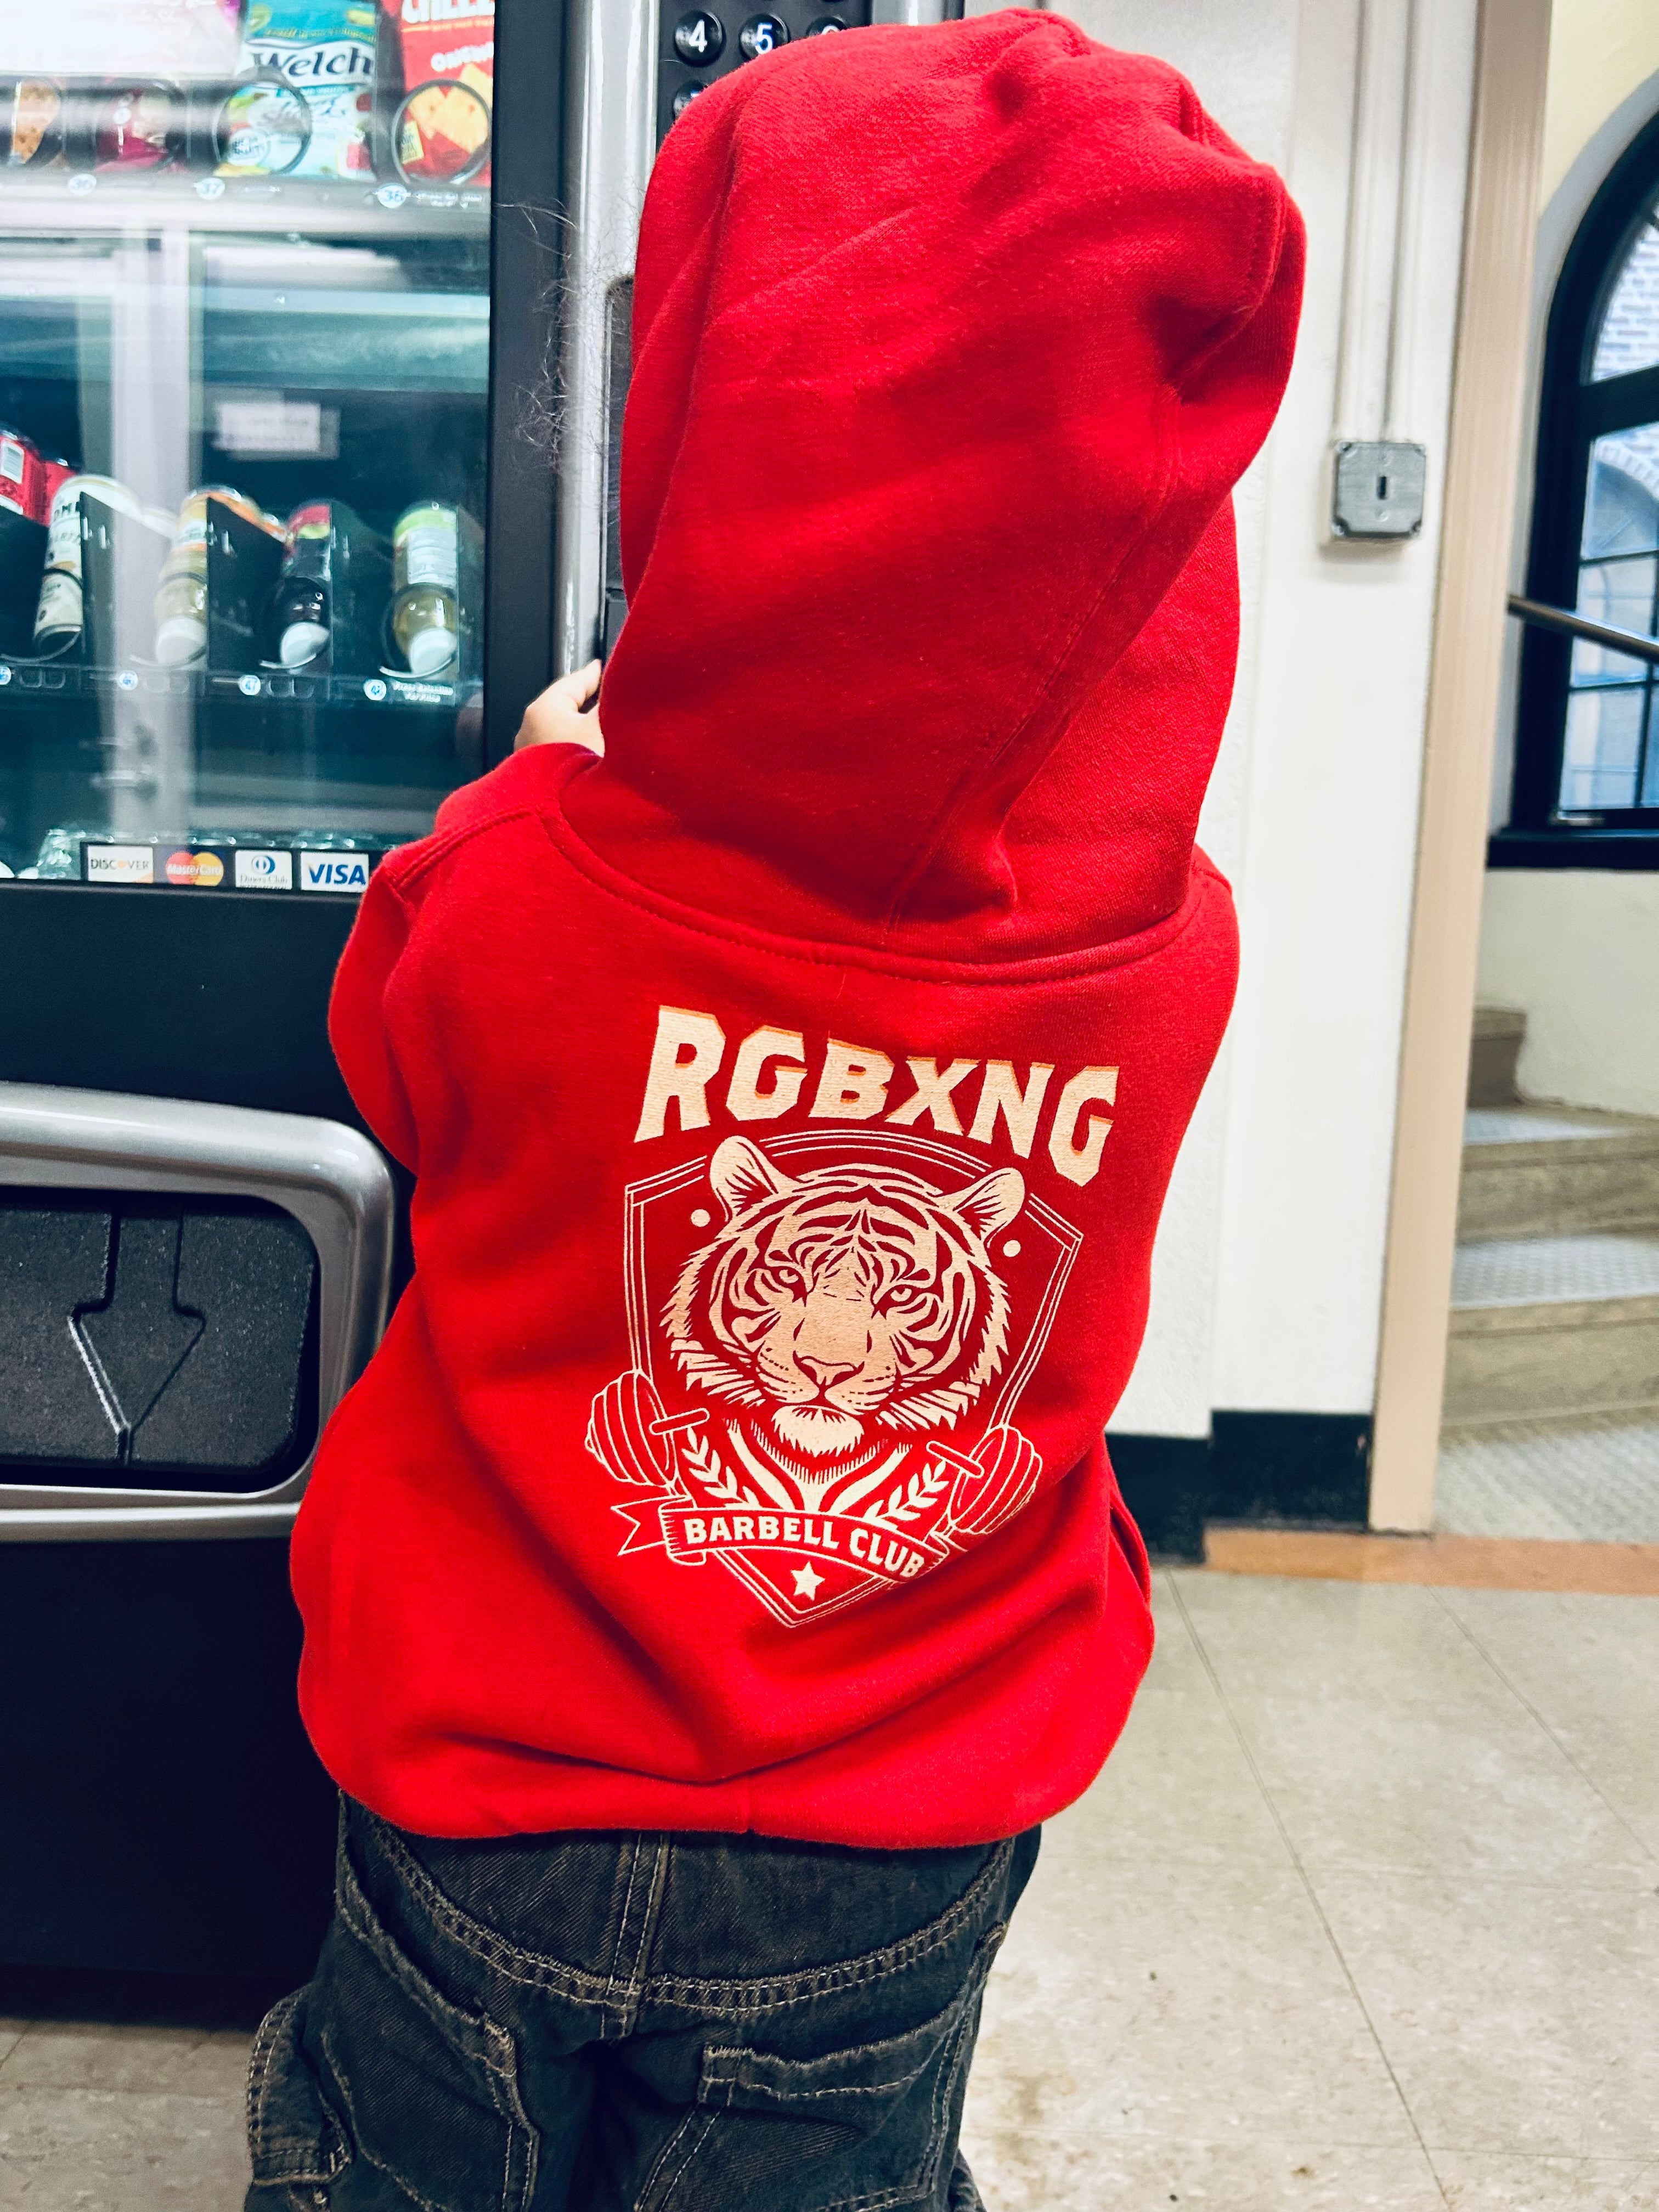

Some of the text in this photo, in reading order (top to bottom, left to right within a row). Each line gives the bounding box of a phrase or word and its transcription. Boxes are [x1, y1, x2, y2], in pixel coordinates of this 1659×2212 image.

[689, 19, 708, 53] 4
[755, 22, 772, 54] 5
[91, 859, 149, 870] DISCOVER
[167, 863, 222, 875] MasterCard
[308, 864, 366, 885] VISA
[240, 874, 287, 883] Diners Club
[634, 1005, 1120, 1187] RGBXNG
[684, 1516, 924, 1578] BARBELL CLUB
